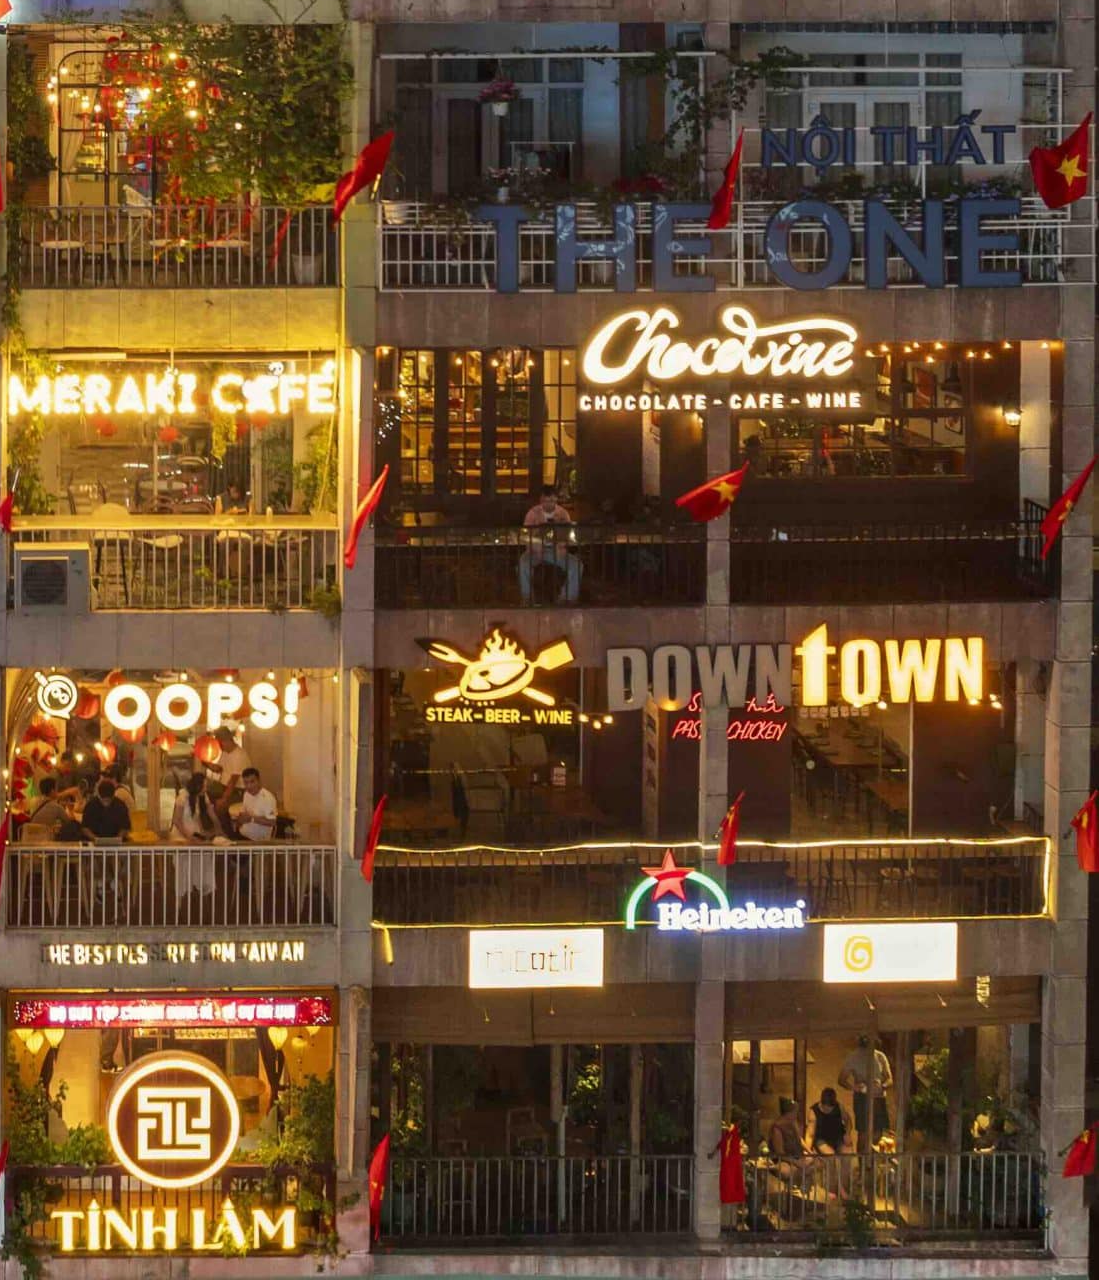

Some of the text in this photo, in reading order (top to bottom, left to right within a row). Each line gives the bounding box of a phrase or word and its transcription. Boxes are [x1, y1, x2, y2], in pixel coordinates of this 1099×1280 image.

[760, 108, 1019, 175] NỘI THẤT
[478, 194, 1024, 294] THE ONE
[7, 372, 198, 416] MERAKI
[579, 394, 707, 411] CHOCOLATE
[729, 393, 784, 409] CAFE
[806, 392, 862, 409] WINE
[103, 681, 300, 731] OOPS!
[425, 706, 474, 723] STEAK
[485, 708, 521, 724] BEER
[534, 709, 573, 725] WINE
[726, 719, 787, 742] CHICKEN
[656, 899, 806, 931] Heineken
[73, 943, 113, 965] BEST
